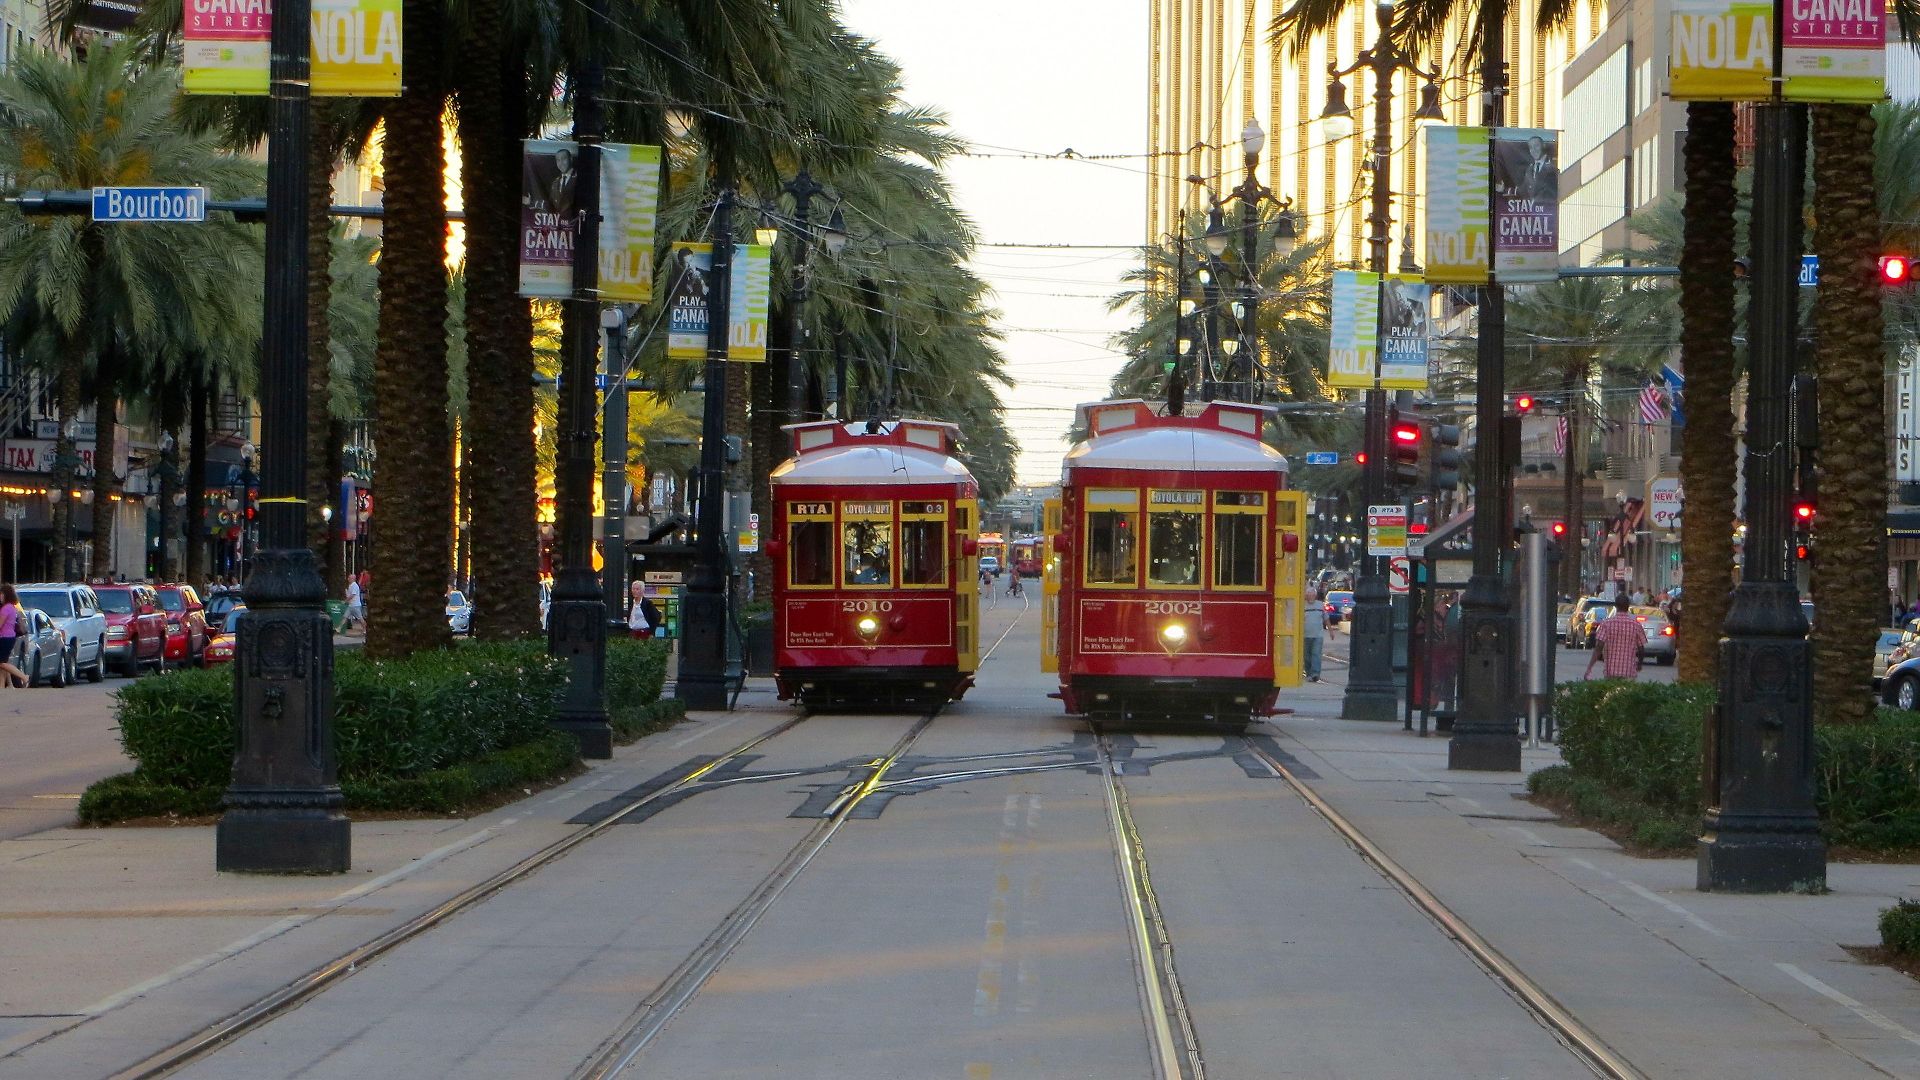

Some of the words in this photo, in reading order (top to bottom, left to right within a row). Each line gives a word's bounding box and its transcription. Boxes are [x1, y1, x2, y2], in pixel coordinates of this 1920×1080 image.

[1792, 0, 1878, 22] CANAL
[194, 16, 263, 27] STREE
[1792, 23, 1878, 35] STREET
[311, 10, 400, 64] NOLA
[1673, 15, 1773, 69] NOLA
[1456, 144, 1489, 231] TOWN
[109, 189, 198, 218] Bourbon
[625, 161, 660, 247] TOWN
[1508, 200, 1535, 213] STAY
[534, 213, 560, 227] STAY
[1500, 217, 1552, 236] CANAL
[525, 229, 575, 250] CANAL
[1428, 231, 1487, 265] NOLA
[1500, 236, 1552, 244] STREET
[525, 249, 569, 258] STREE
[599, 248, 652, 284] NOLA
[745, 257, 769, 320] TOWN
[679, 296, 701, 307] PLAY
[1354, 284, 1378, 347] TOWN
[673, 322, 705, 330] STREE
[1391, 326, 1411, 336] PLAY
[1385, 339, 1424, 354] CANAL
[1330, 349, 1376, 375] NOLA
[7, 447, 36, 468] TAX
[1654, 492, 1673, 500] NEW
[797, 504, 828, 514] RTA
[842, 601, 893, 612] 2010
[1145, 601, 1201, 614] 2002
